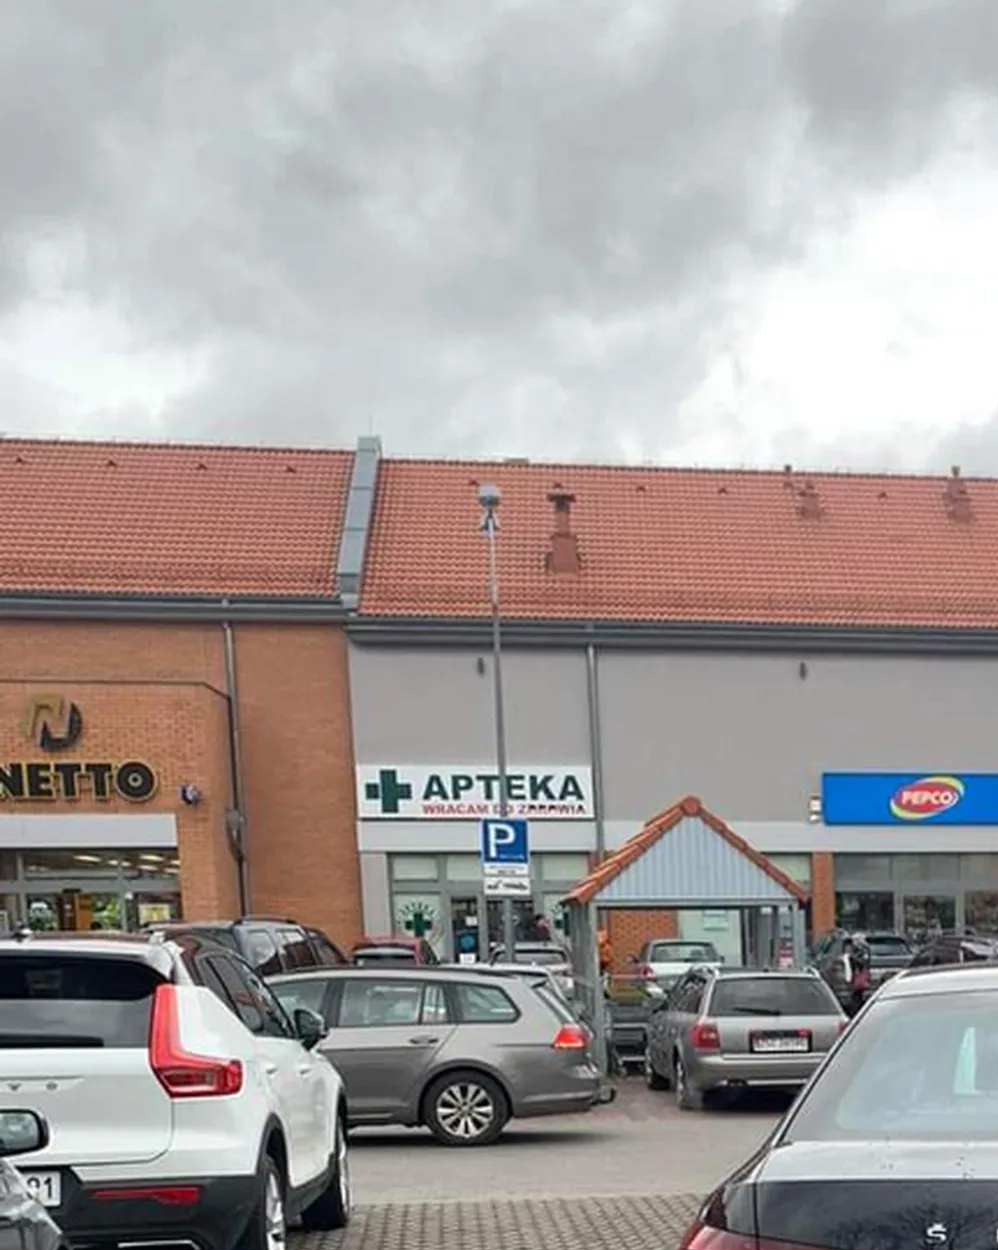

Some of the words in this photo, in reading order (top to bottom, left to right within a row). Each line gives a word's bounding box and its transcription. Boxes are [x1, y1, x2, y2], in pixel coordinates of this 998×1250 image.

[0, 762, 155, 798] NETTO
[423, 774, 584, 800] APTEKA
[422, 803, 488, 815] WRACAM
[901, 789, 953, 806] PEPCO
[488, 823, 515, 858] P
